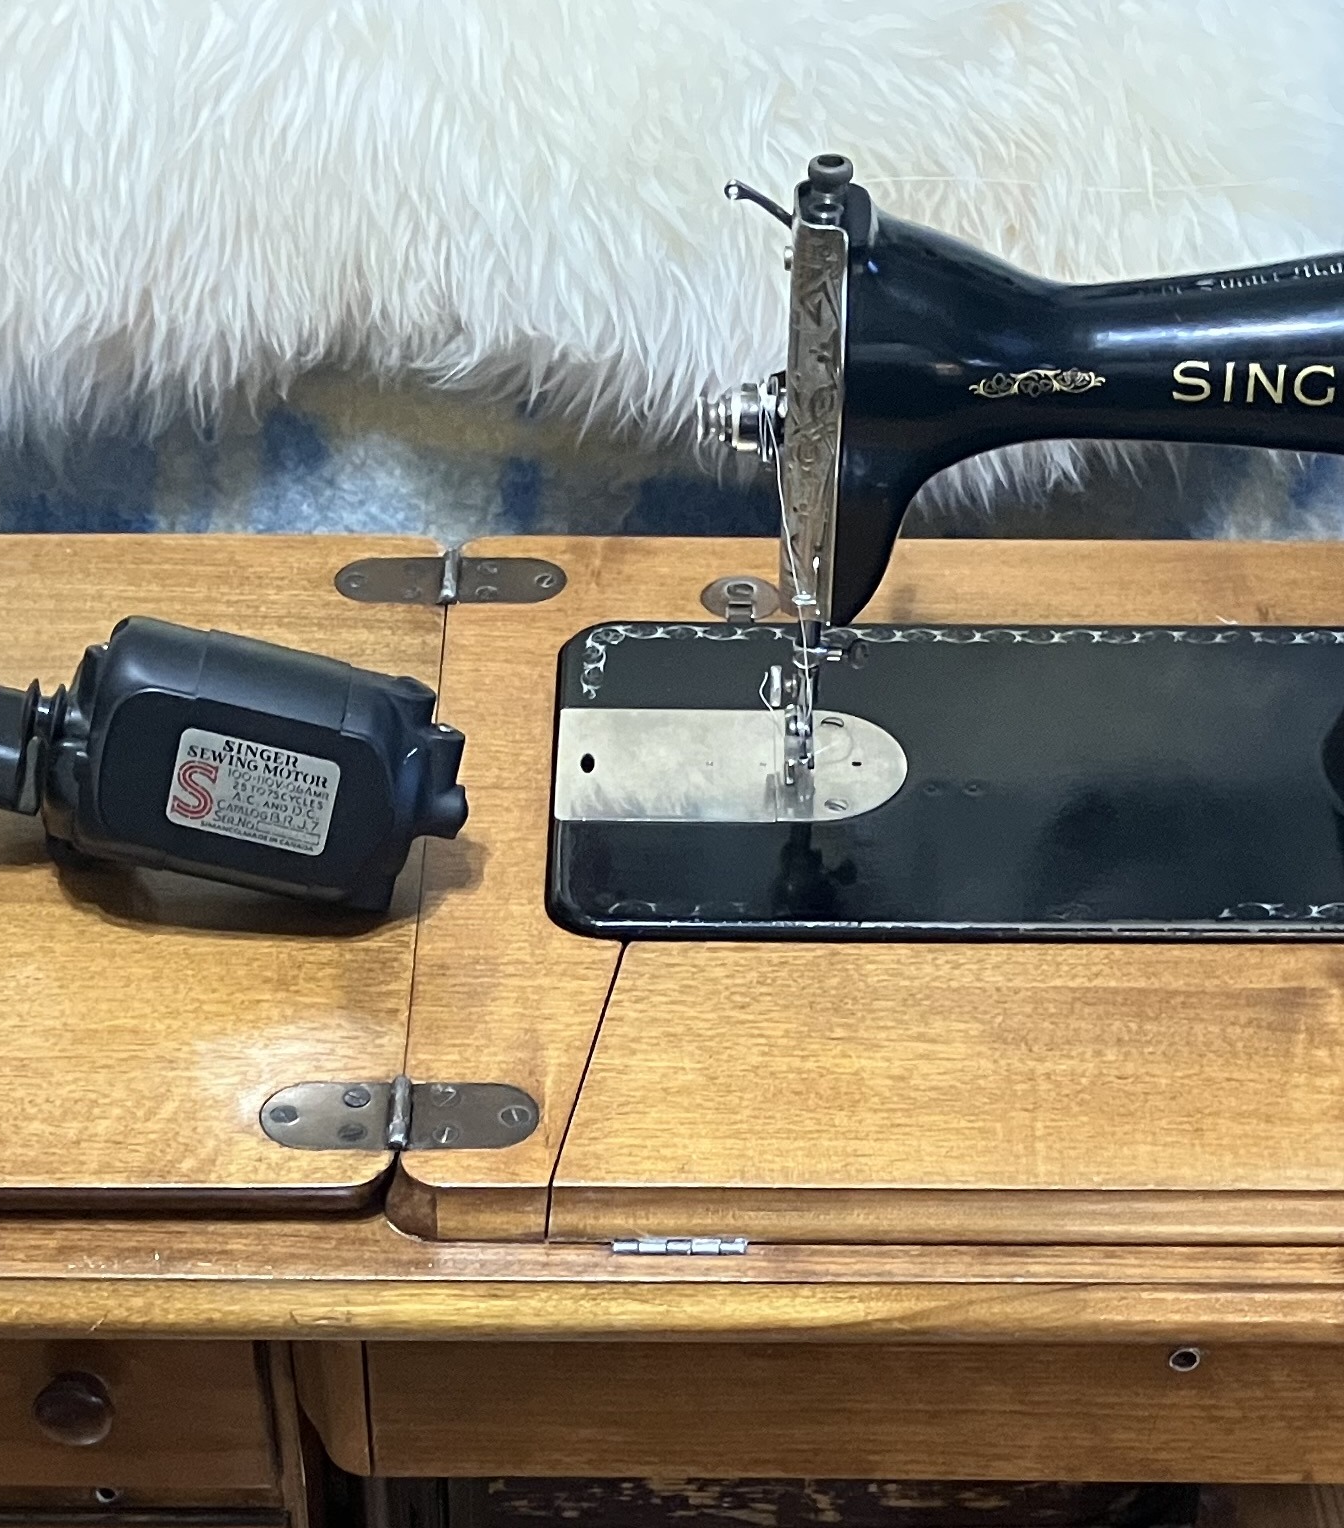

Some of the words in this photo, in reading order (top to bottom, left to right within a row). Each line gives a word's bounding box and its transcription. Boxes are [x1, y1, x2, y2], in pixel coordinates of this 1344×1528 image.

[186, 744, 258, 771] SEWING
[262, 763, 327, 788] MOTOR
[222, 739, 298, 768] SINGER
[170, 760, 219, 820] S
[280, 792, 323, 810] CYCLES
[216, 798, 268, 821] CATALOG
[262, 800, 288, 812] AND
